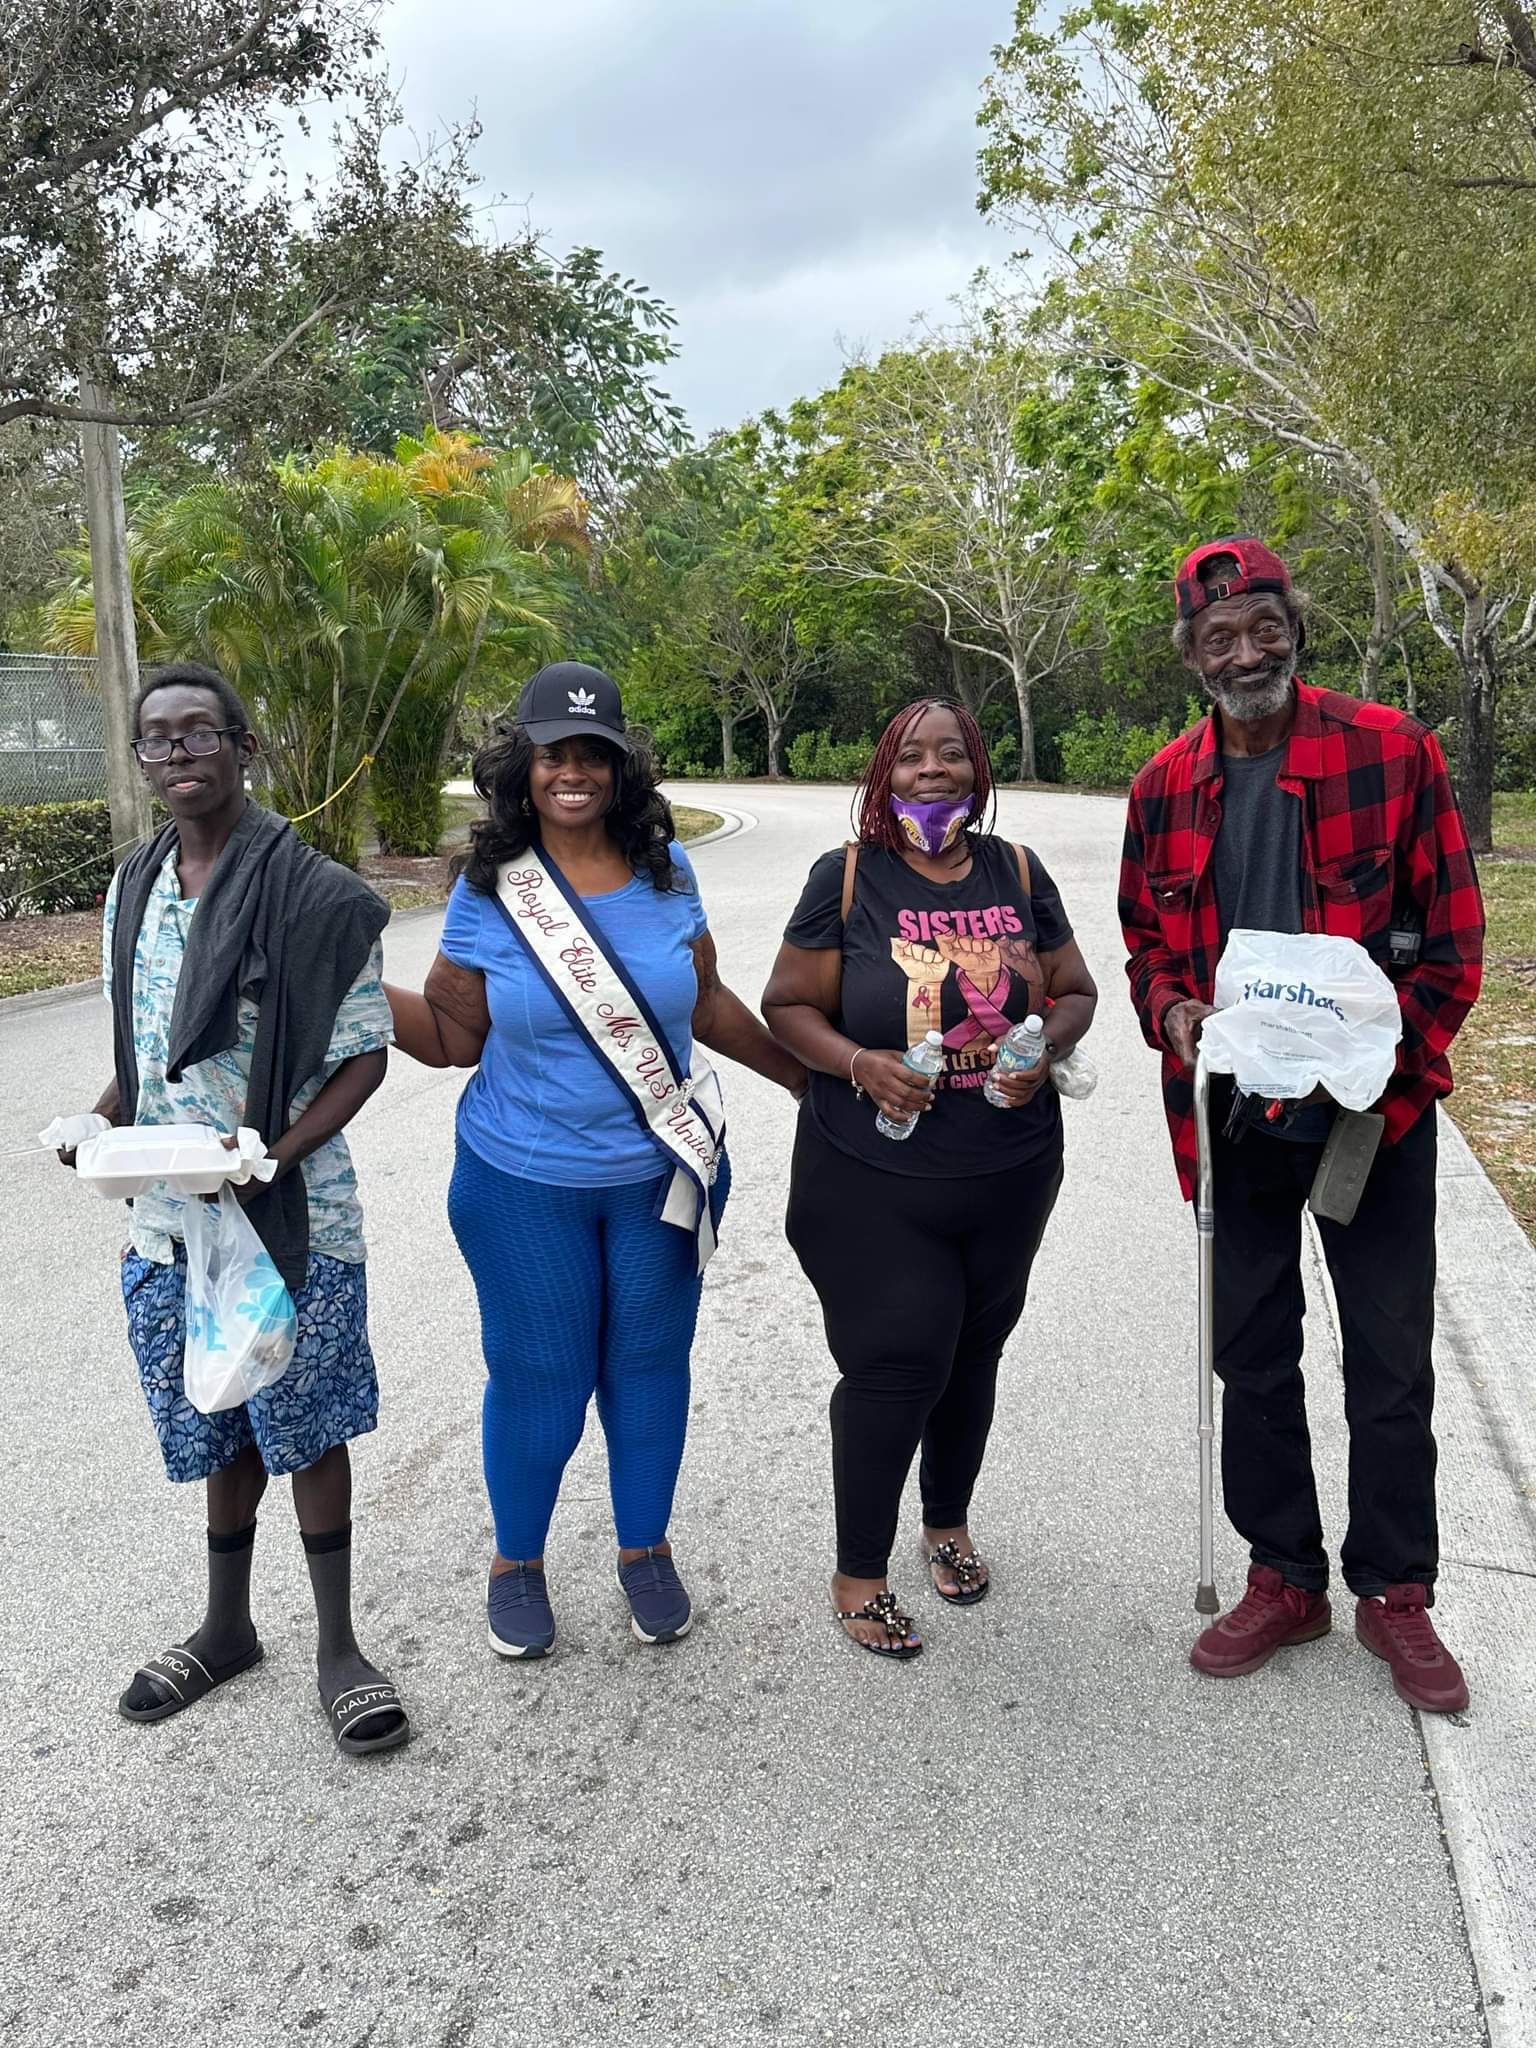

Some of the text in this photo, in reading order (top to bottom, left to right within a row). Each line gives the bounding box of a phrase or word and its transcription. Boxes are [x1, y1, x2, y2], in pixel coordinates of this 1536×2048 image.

[568, 705, 596, 715] adidas
[897, 905, 1023, 941] SISTERS
[507, 869, 569, 937] Royal
[560, 937, 598, 993] Elite
[596, 1003, 641, 1052] Ms.
[336, 1690, 397, 1720] NAUTIC
